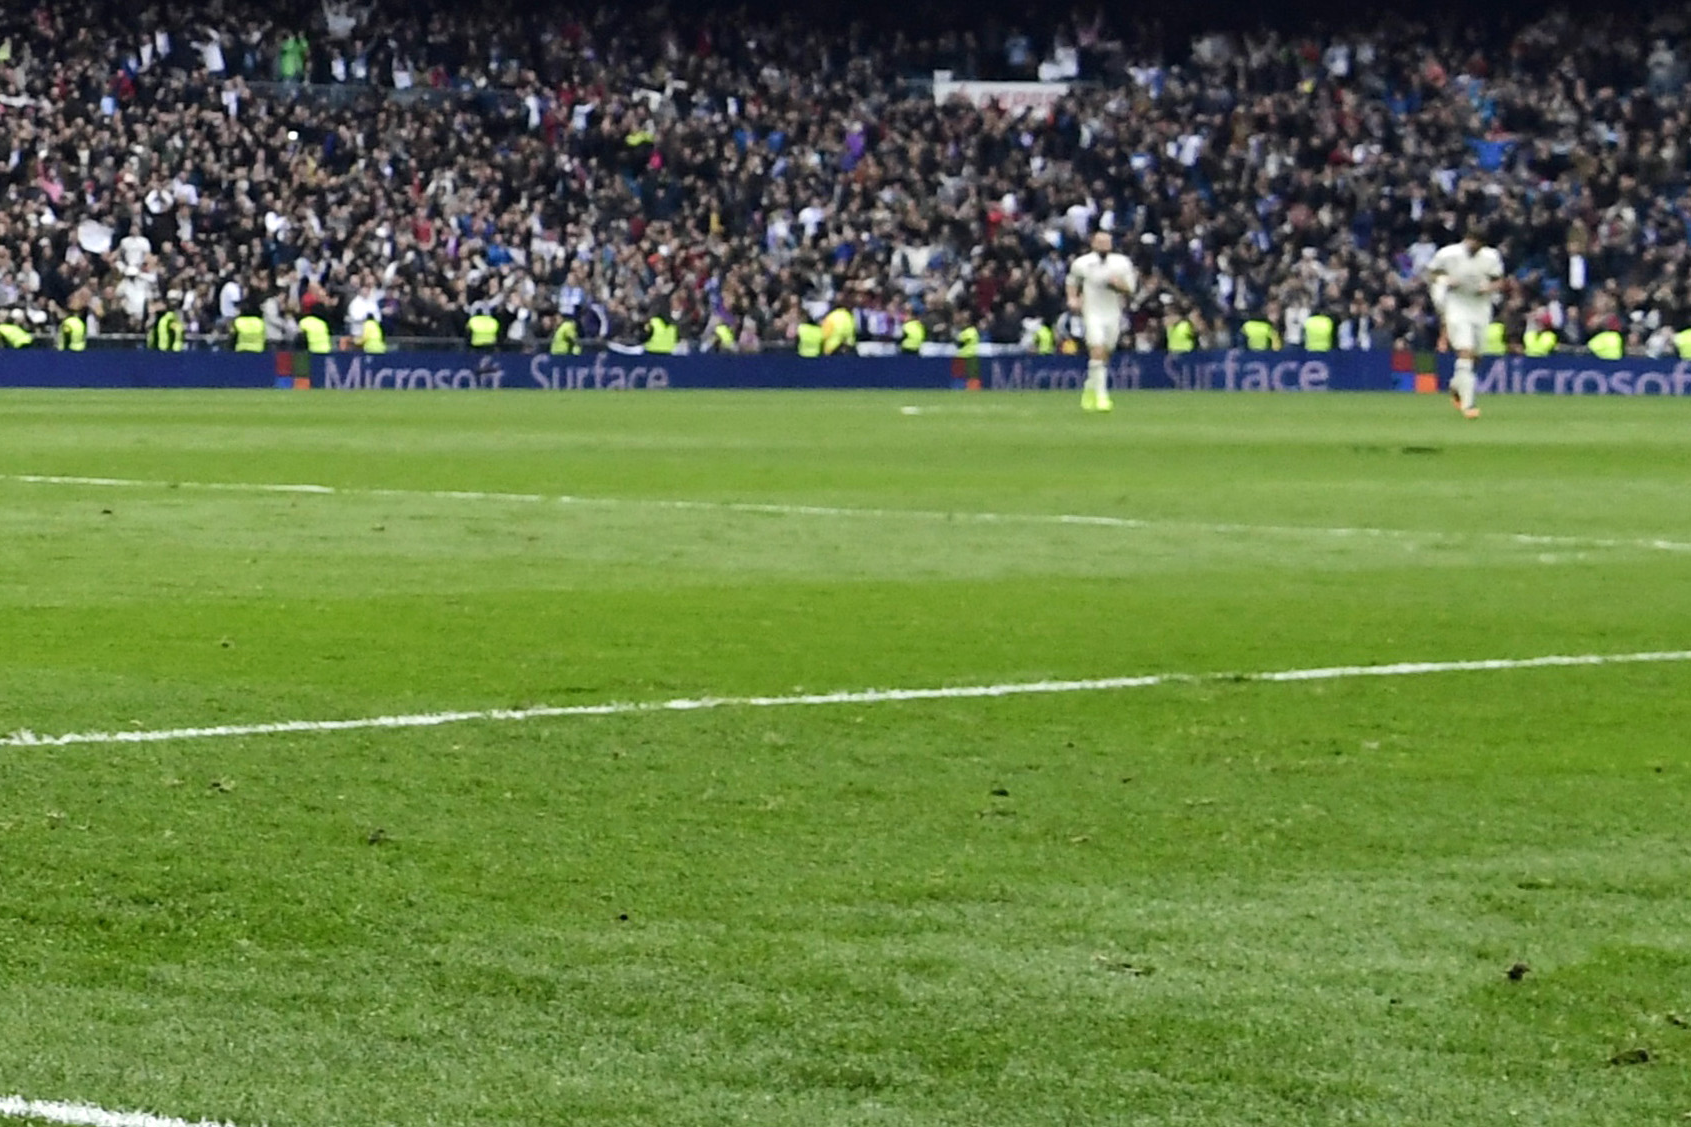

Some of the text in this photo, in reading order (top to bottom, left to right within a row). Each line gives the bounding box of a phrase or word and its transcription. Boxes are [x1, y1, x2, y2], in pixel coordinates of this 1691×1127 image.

[323, 352, 670, 390] Microsoft Surface
[1164, 348, 1330, 391] Surface
